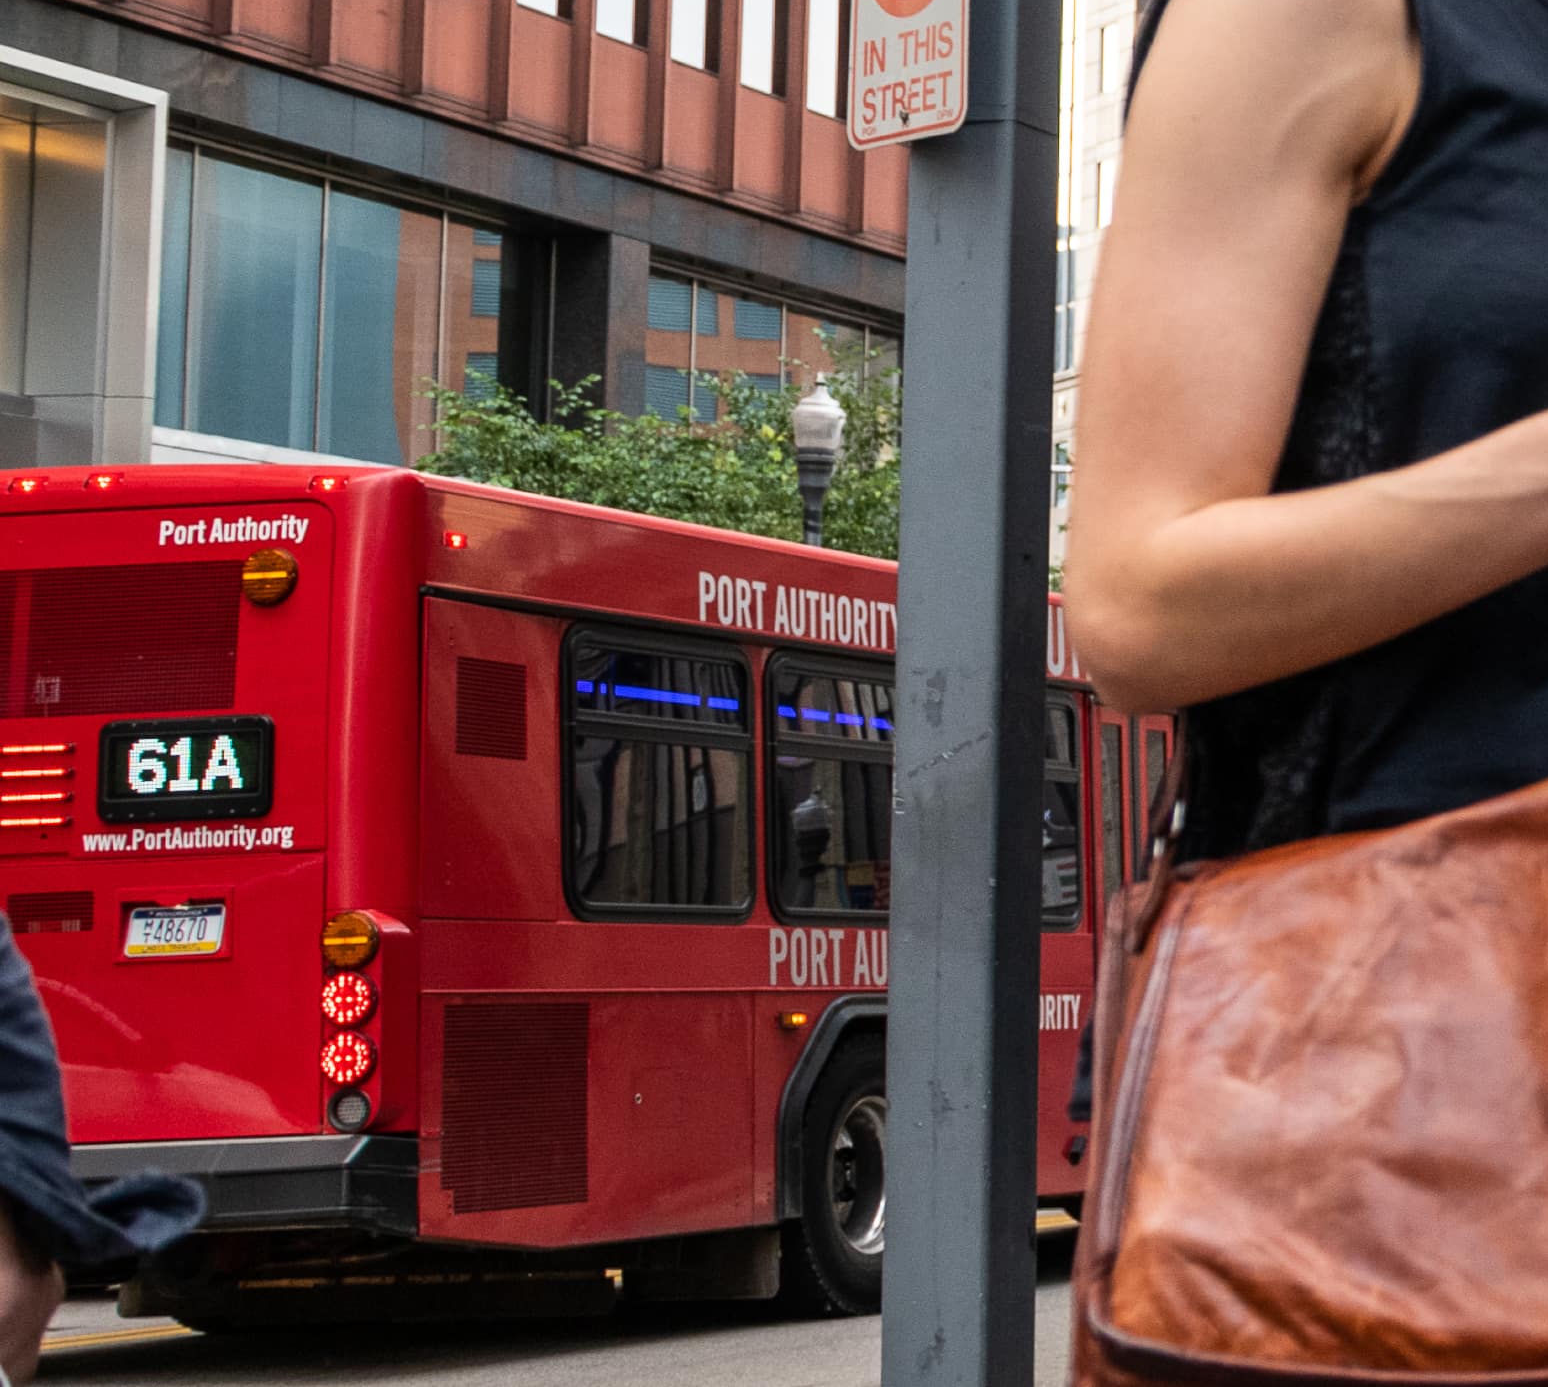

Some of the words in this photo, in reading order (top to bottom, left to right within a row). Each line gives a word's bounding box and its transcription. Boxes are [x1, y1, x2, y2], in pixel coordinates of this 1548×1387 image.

[863, 36, 887, 78] IN
[898, 20, 954, 69] THIS
[862, 70, 953, 126] STREET
[158, 519, 206, 546] Port
[209, 514, 309, 543] Authority
[698, 571, 767, 631] PORT
[127, 734, 244, 794] 61A
[82, 824, 295, 852] www.PortAuthority.org
[768, 927, 845, 987] PORT
